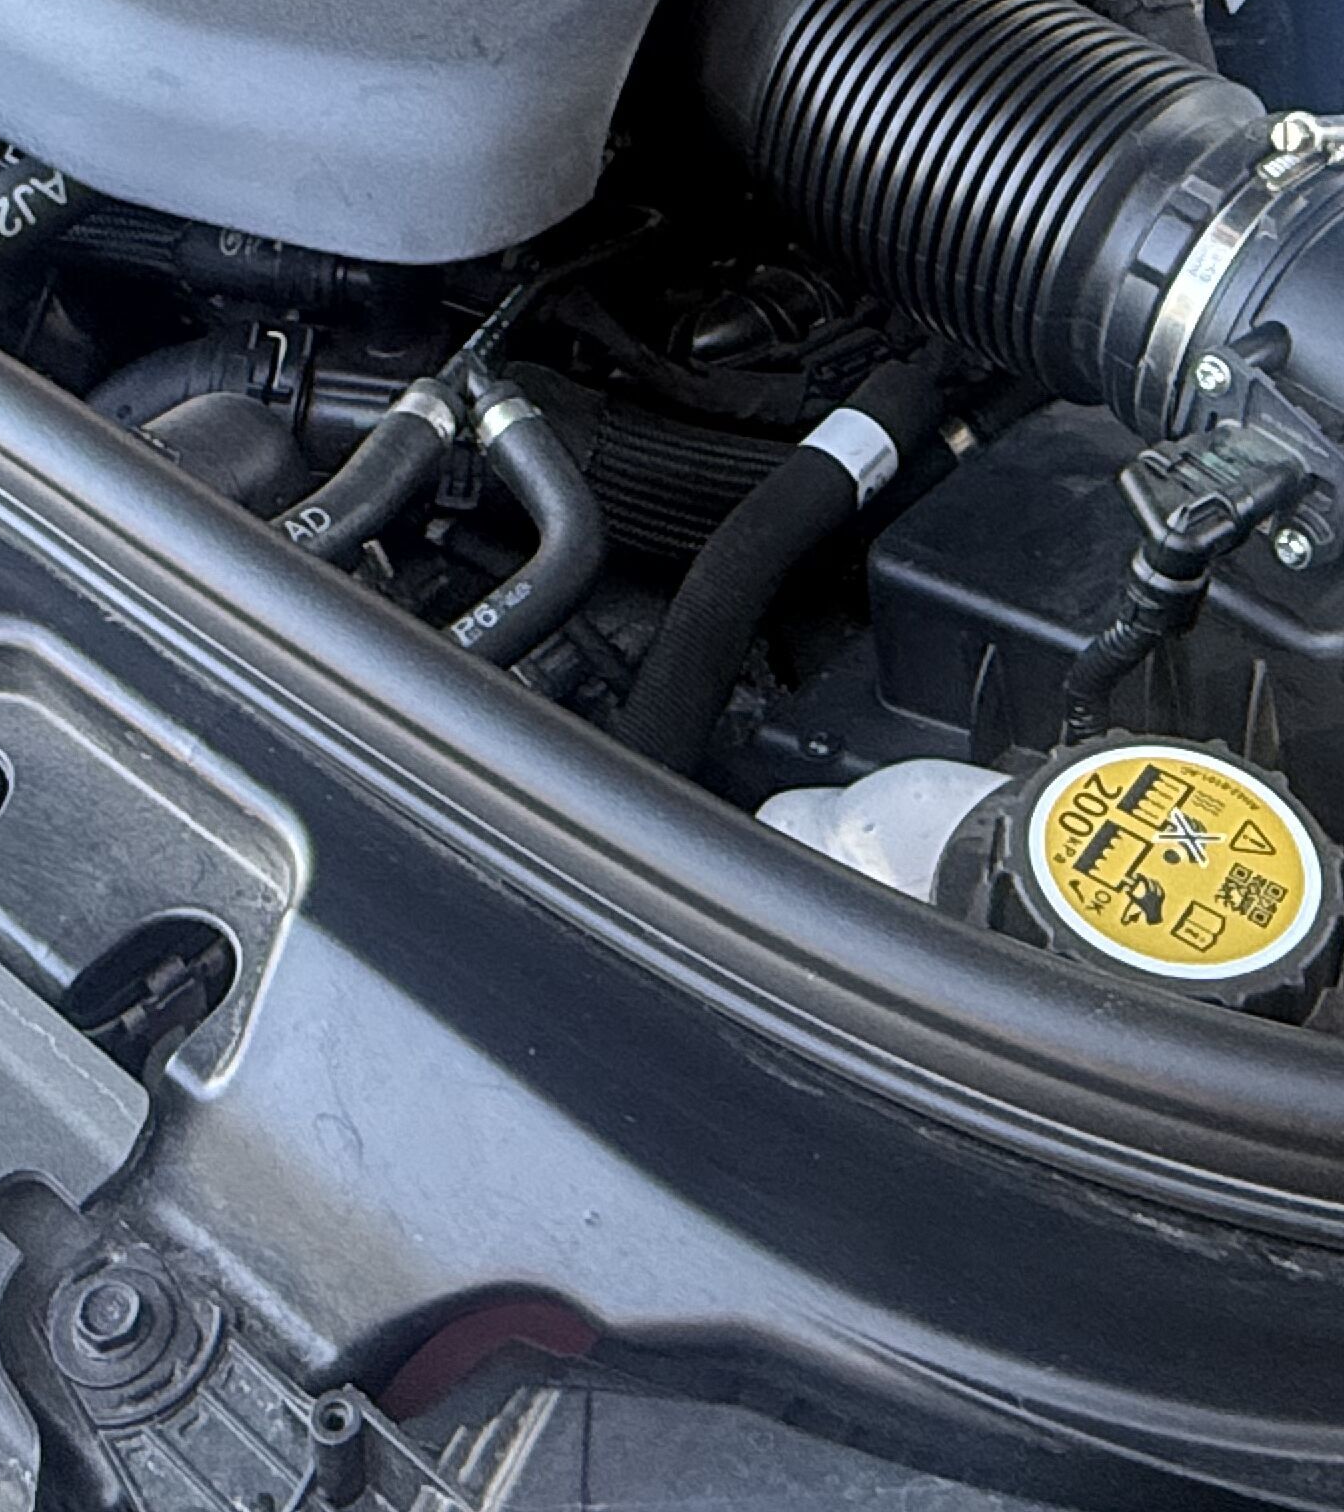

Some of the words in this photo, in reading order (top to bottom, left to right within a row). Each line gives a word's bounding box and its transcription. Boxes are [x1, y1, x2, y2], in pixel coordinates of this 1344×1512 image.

[284, 506, 332, 543] AD
[1059, 772, 1123, 837] 200
[1054, 836, 1083, 864] kPa
[1085, 889, 1111, 918] OK
